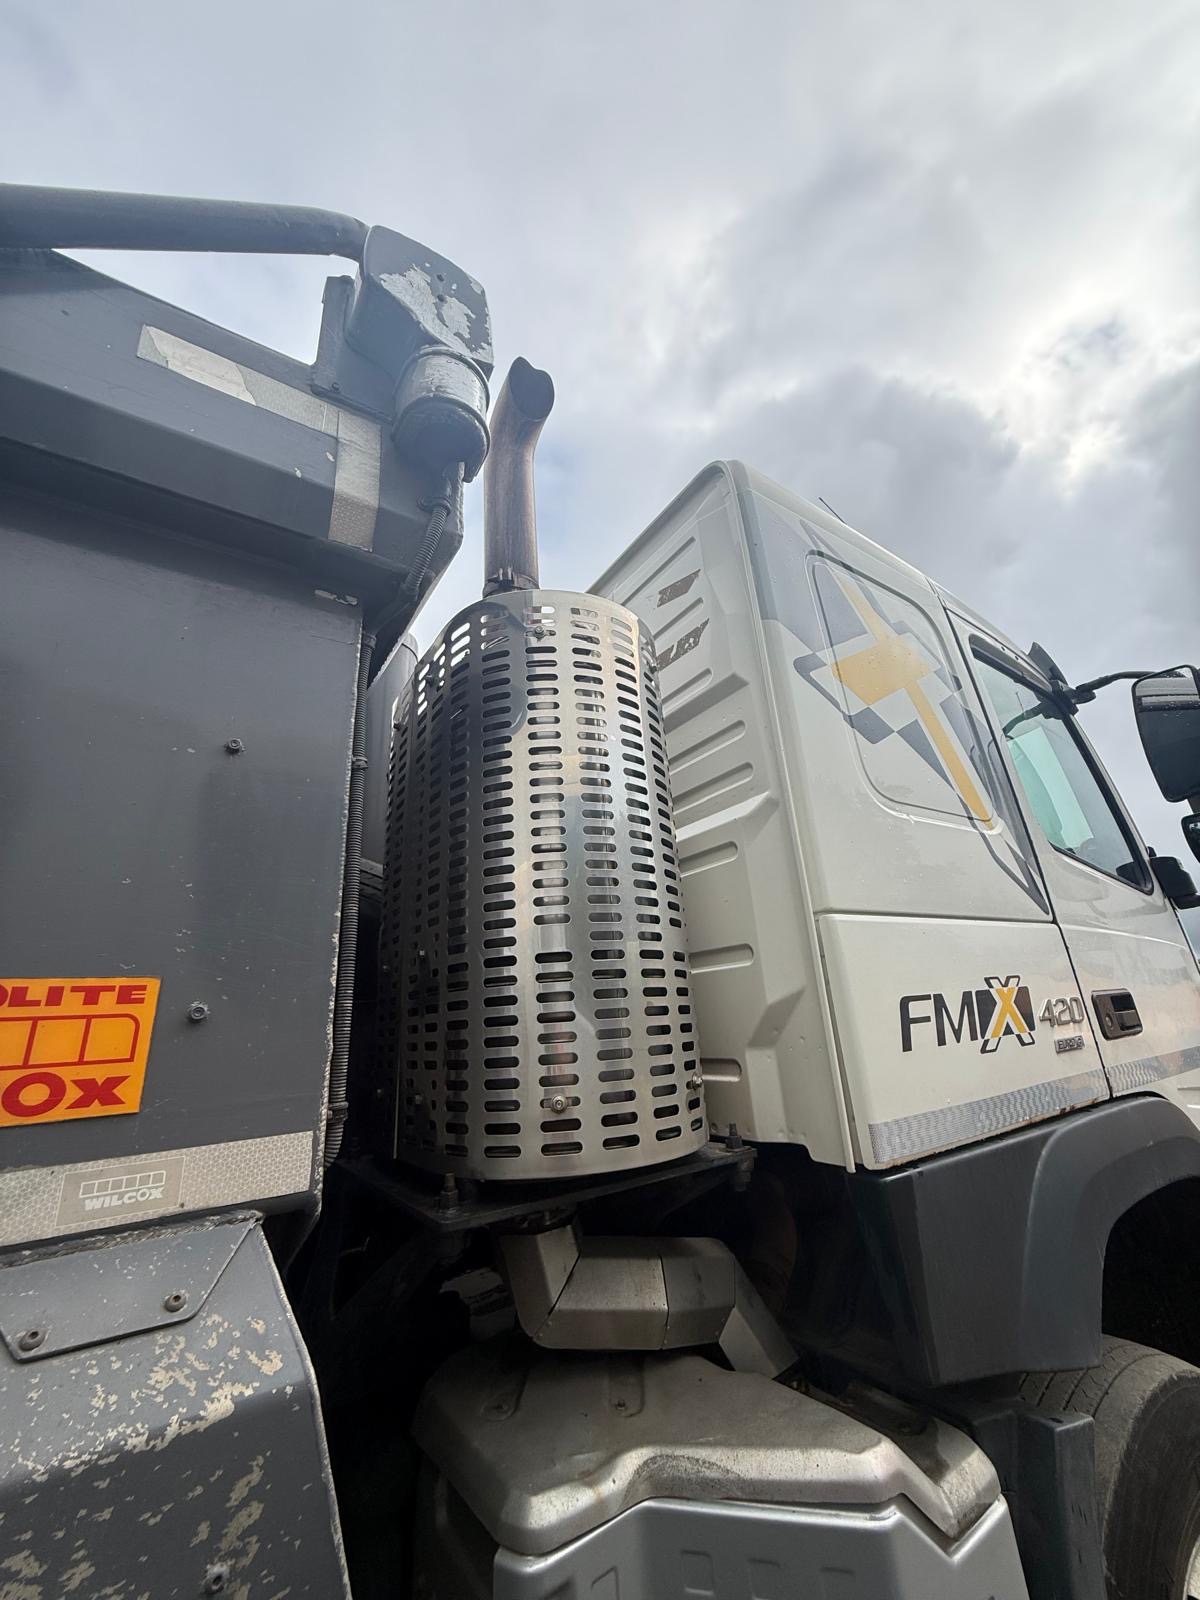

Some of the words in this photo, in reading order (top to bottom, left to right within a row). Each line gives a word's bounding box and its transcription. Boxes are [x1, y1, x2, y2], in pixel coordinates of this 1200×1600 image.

[900, 975, 1035, 1053] FMX
[1039, 997, 1085, 1027] 420
[85, 1187, 163, 1210] WILCOX
